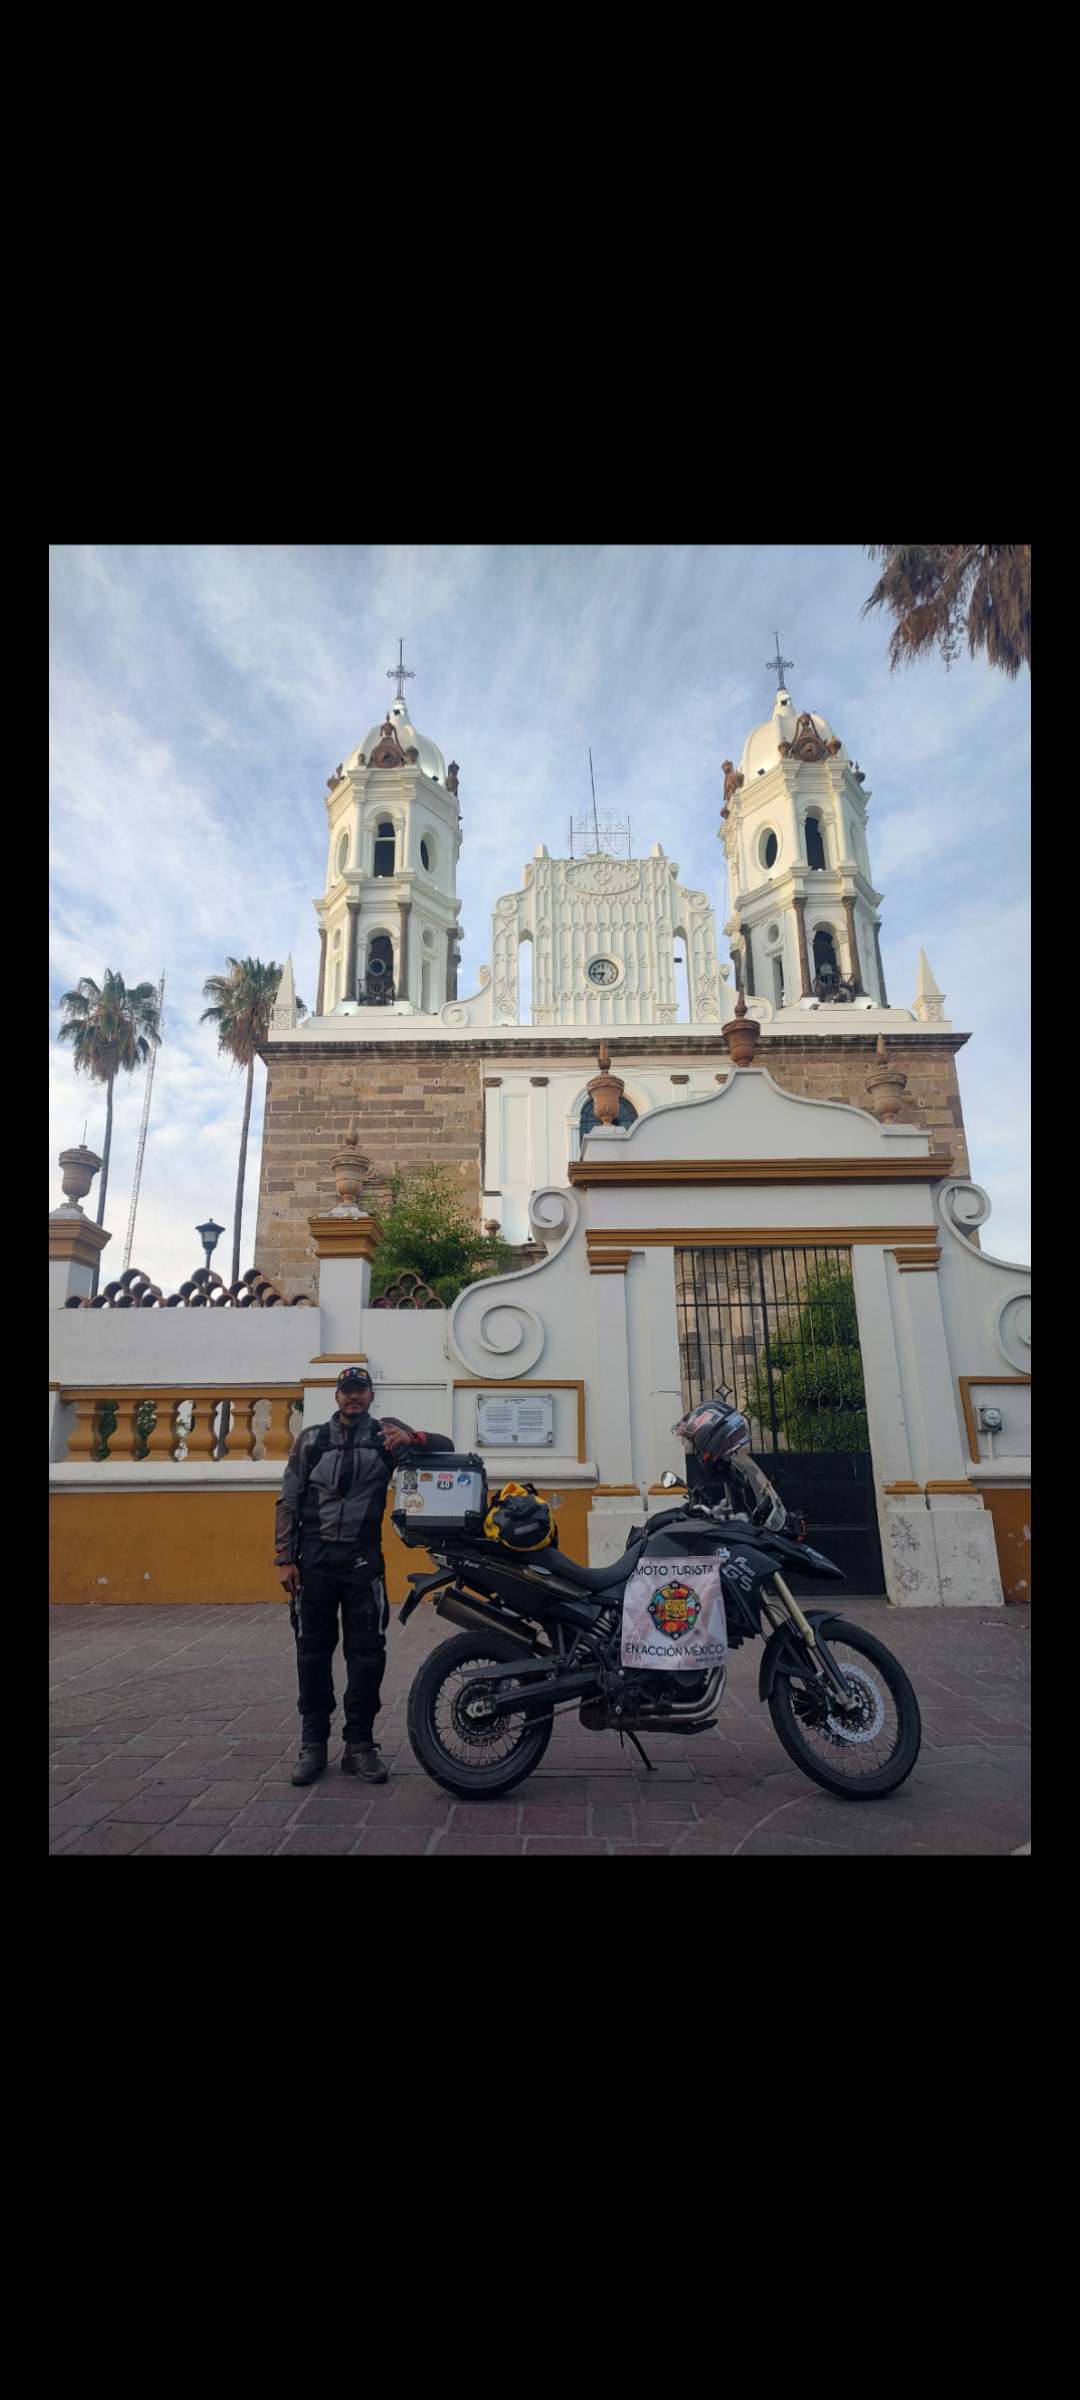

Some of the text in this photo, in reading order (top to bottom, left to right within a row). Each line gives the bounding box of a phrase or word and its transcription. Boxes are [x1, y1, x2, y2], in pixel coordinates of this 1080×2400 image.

[635, 1564, 714, 1576] MOTO TURISTA
[734, 1556, 756, 1577] F800
[721, 1564, 753, 1592] GS
[625, 1643, 724, 1657] EN ACCIÓN MÉXICO
